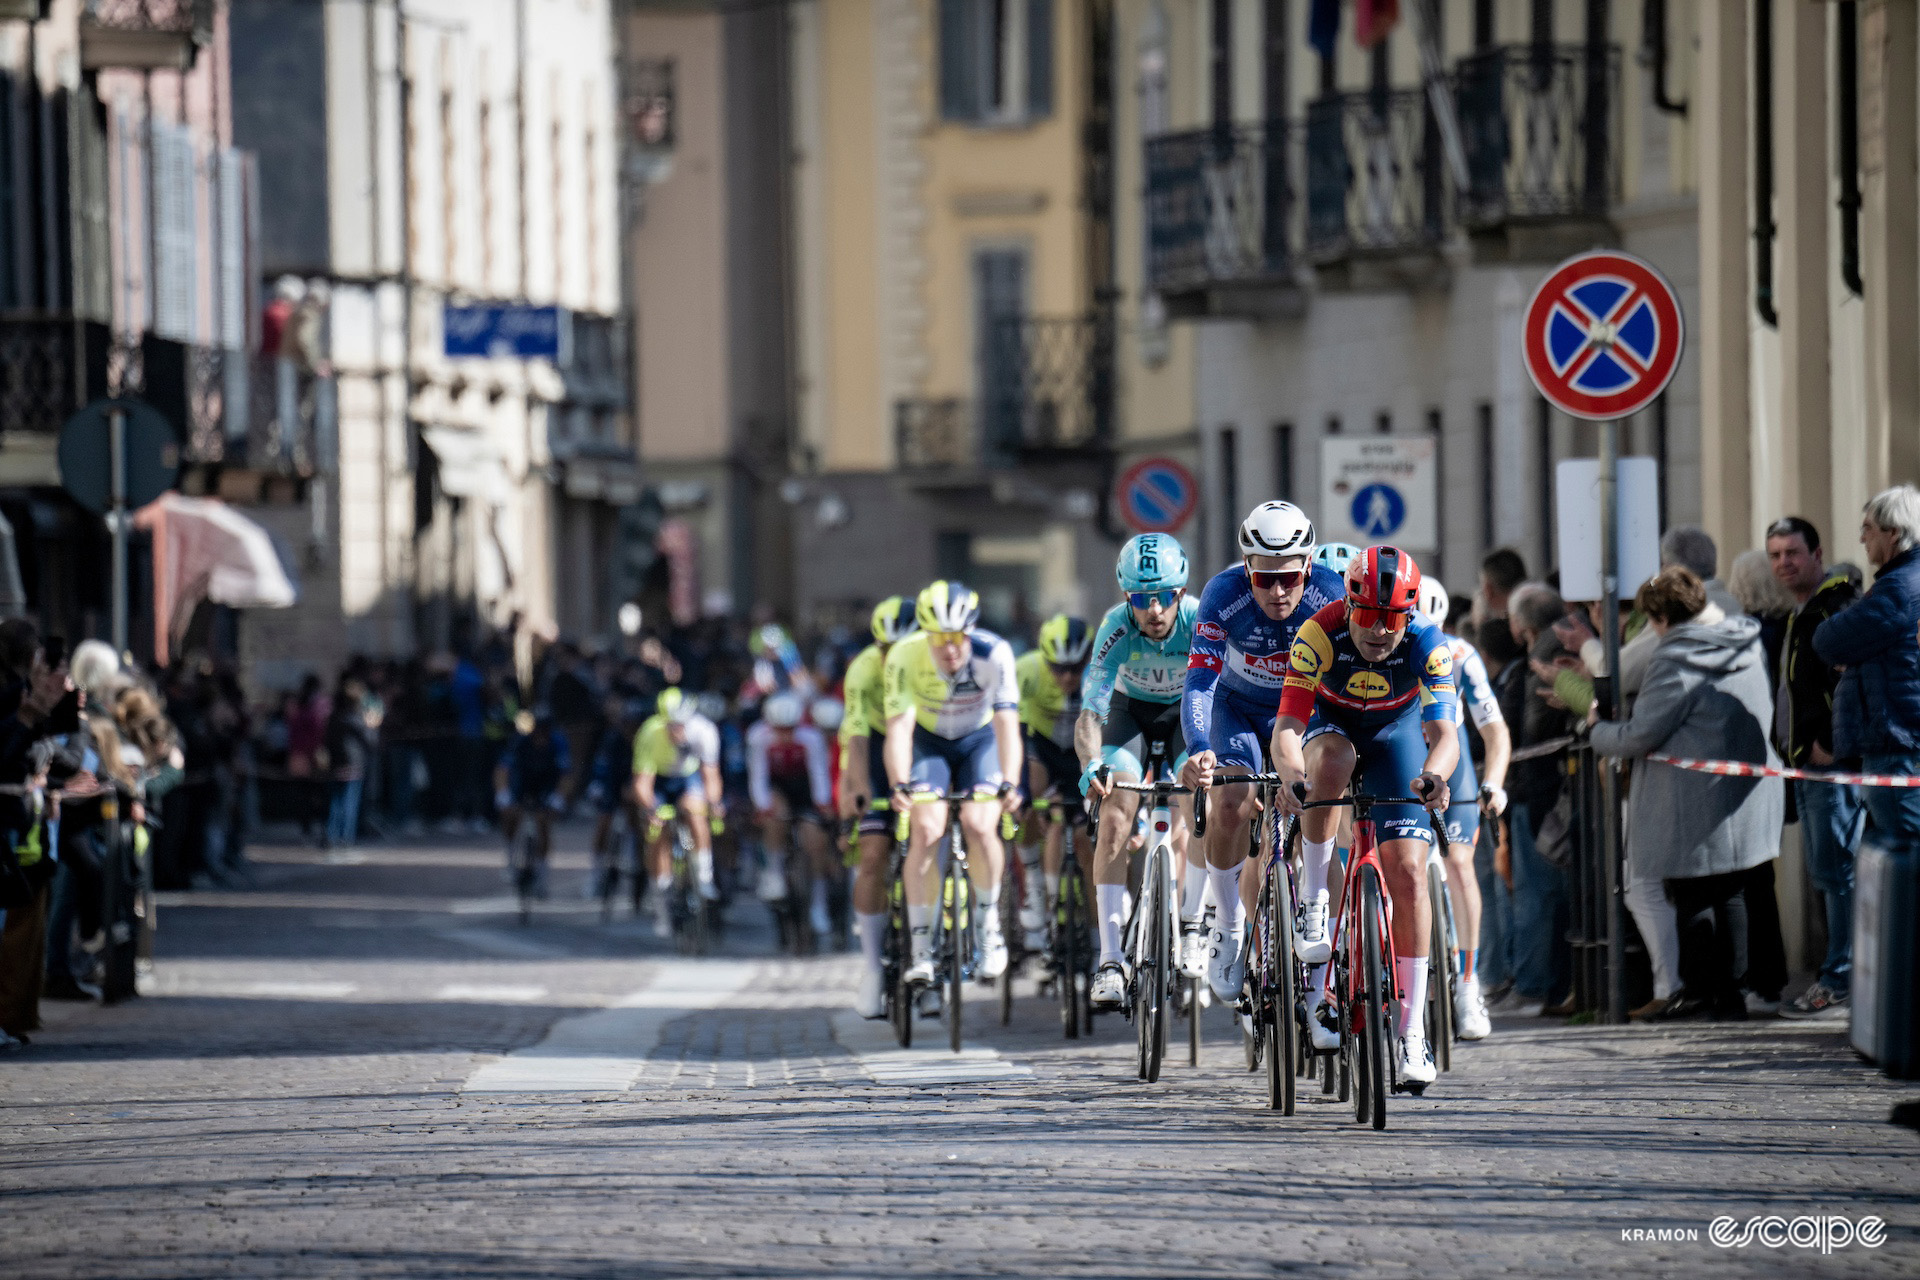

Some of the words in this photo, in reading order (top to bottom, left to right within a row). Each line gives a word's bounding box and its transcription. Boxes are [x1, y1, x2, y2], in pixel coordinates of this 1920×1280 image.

[1303, 584, 1333, 609] Alpe
[1199, 624, 1226, 640] Alpecin
[1191, 697, 1205, 733] WHOOP
[1384, 818, 1418, 829] Santini
[1395, 826, 1432, 842] TR
